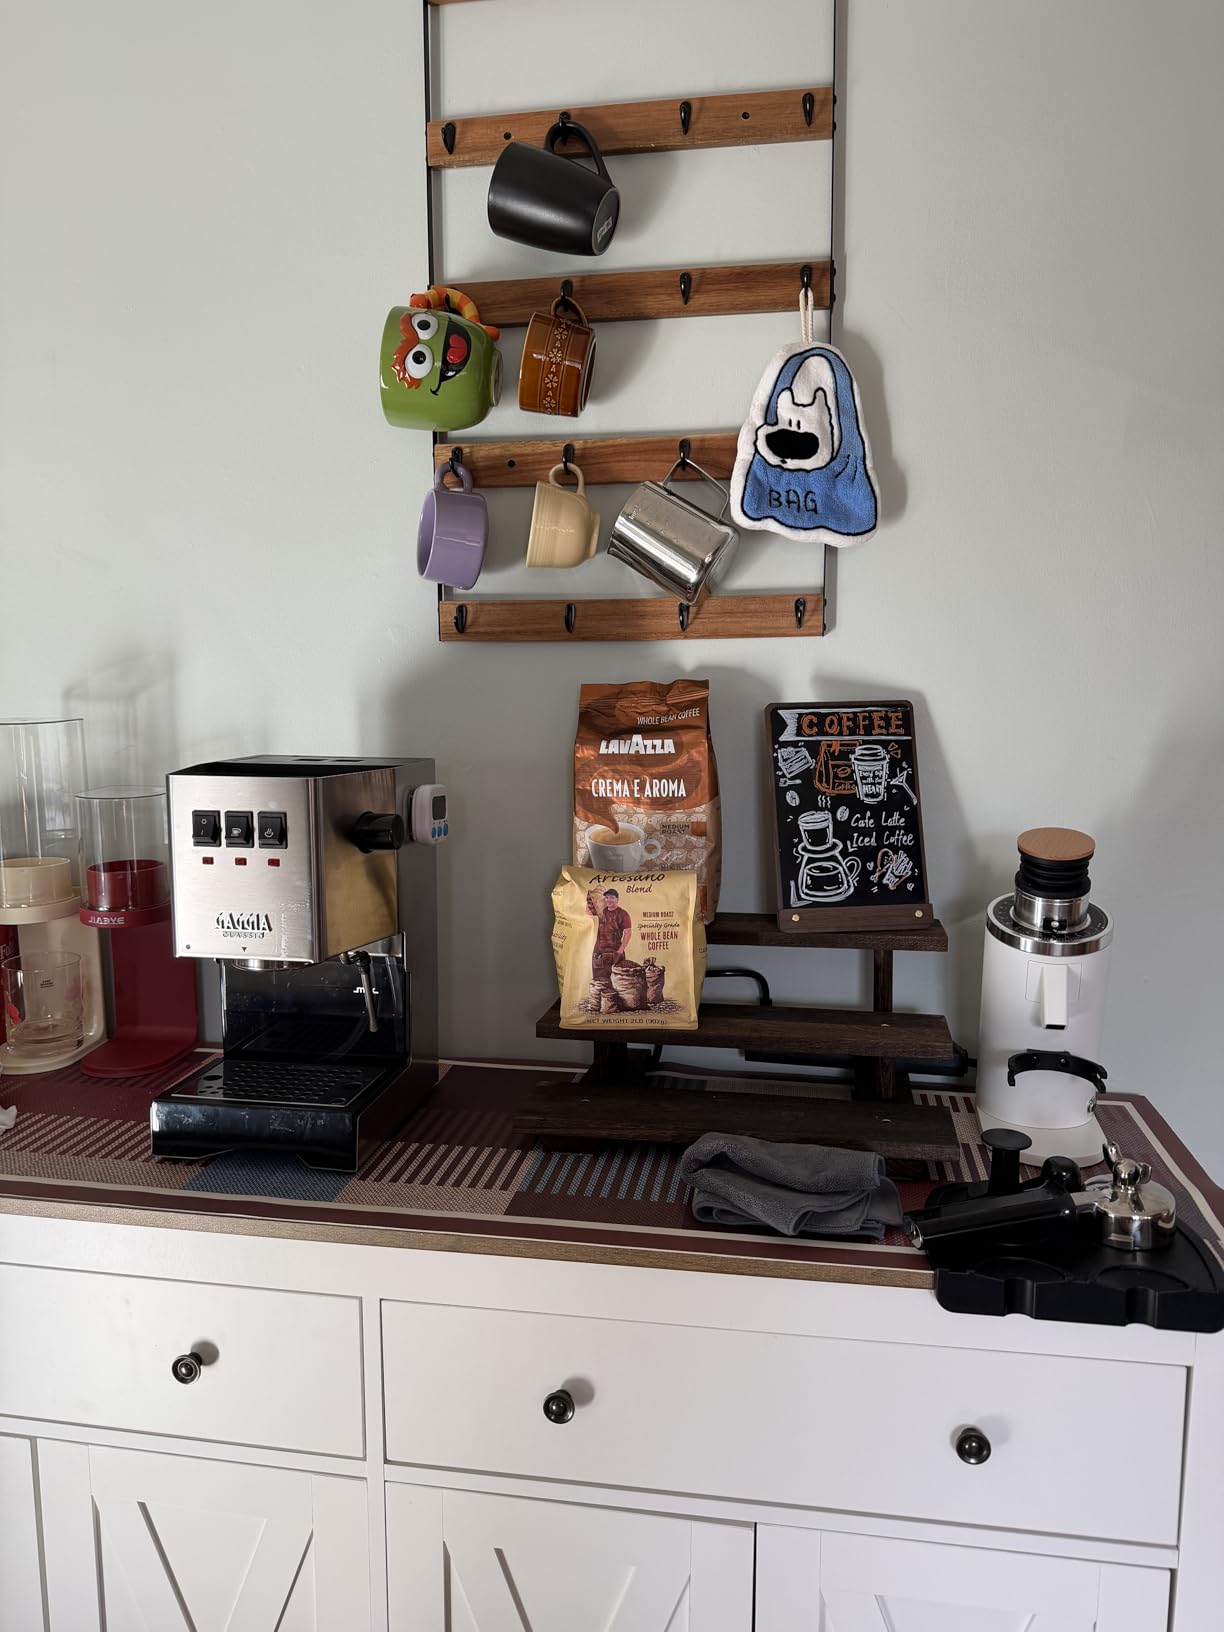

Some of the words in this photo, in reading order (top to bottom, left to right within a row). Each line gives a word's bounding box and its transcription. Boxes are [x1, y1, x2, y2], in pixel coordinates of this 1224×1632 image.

[769, 488, 818, 514] BAG
[637, 716, 660, 725] WHOLE
[660, 713, 677, 724] BEAN
[677, 707, 701, 719] COFFEE
[800, 710, 905, 736] COFFEE
[599, 734, 676, 754] LAVAZZA
[591, 778, 630, 798] CREMA
[633, 778, 641, 798] E
[644, 778, 686, 798] AROMA
[850, 810, 875, 828] Cafe
[881, 811, 906, 826] Latte
[852, 831, 877, 848] Iced
[883, 830, 914, 847] Coffee
[625, 884, 652, 894] Blend
[215, 911, 273, 932] GAGGIA
[637, 922, 662, 931] Specialty
[222, 930, 265, 939] CLASSIC
[640, 931, 661, 941] WHOLE
[662, 930, 679, 940] BEAN
[647, 941, 669, 951] COFFEE
